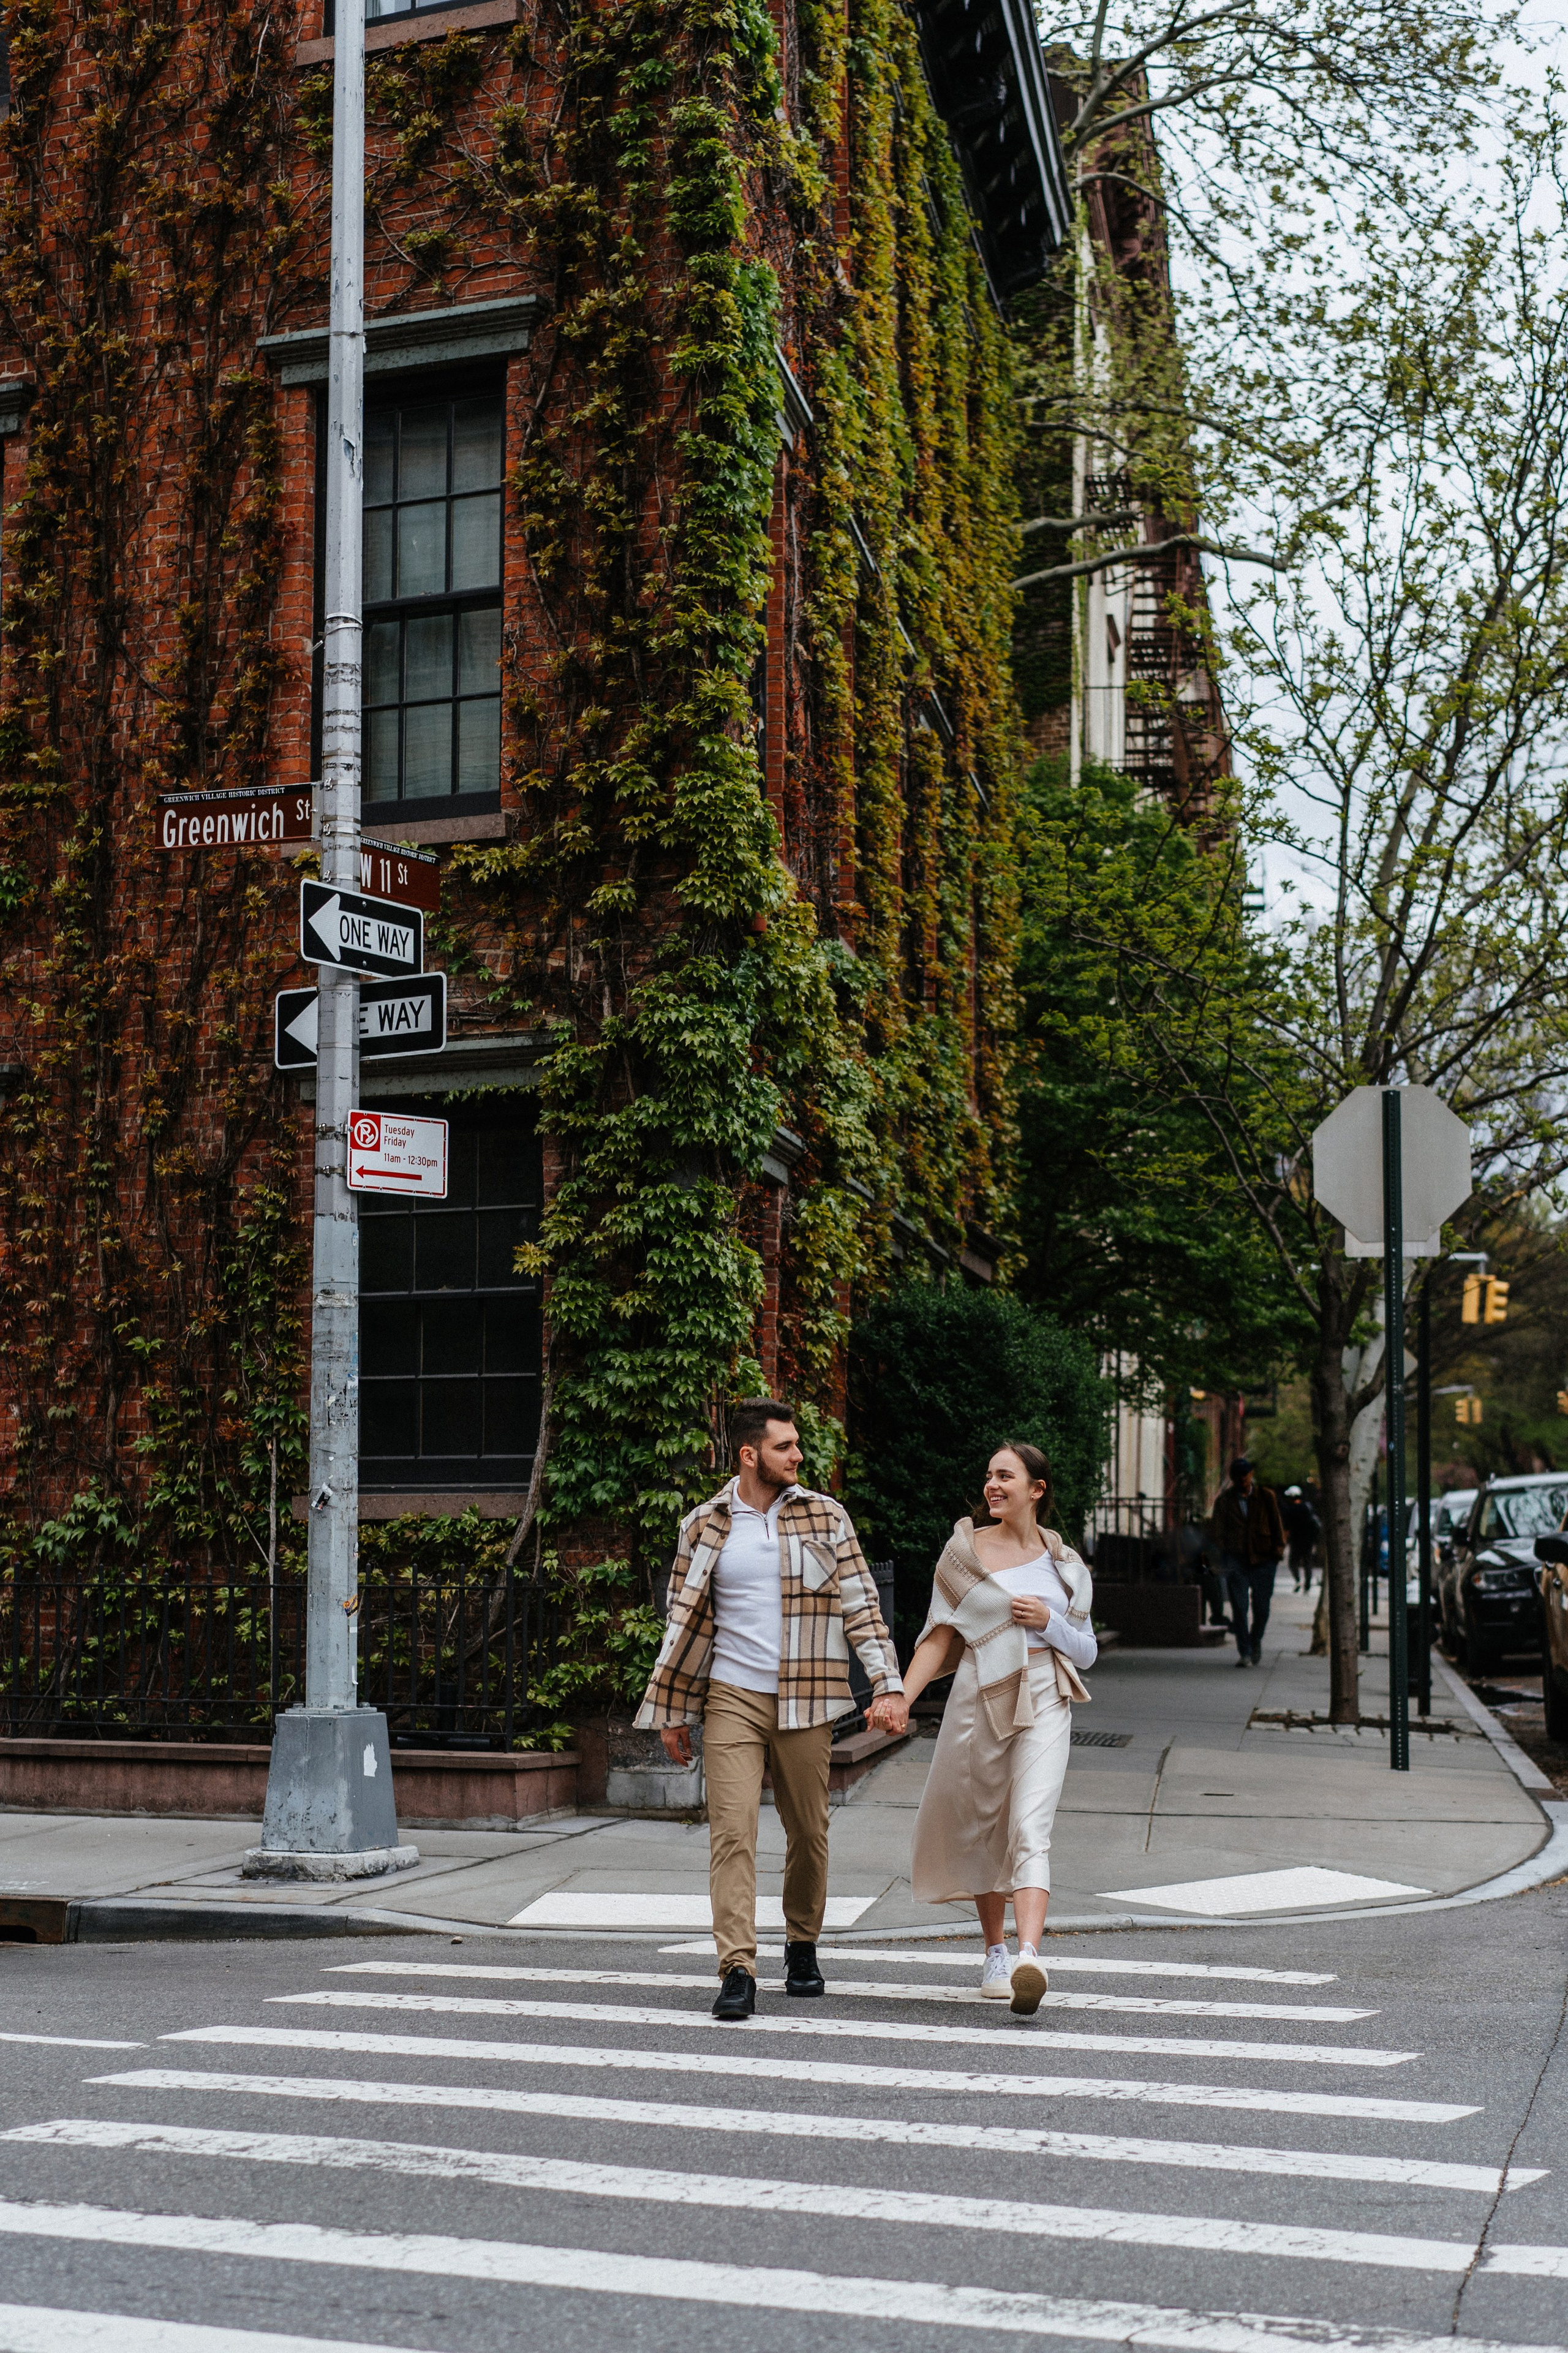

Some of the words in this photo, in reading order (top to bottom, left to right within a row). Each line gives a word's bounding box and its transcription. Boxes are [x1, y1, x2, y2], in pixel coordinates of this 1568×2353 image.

[164, 795, 199, 803] GREENWICH
[163, 802, 284, 848] Greenwich
[296, 799, 311, 821] St
[384, 844, 401, 854] VILLAGE
[401, 850, 418, 859] HISTORIC
[418, 854, 435, 864] DISTRICT
[360, 853, 372, 888] W
[380, 858, 391, 893] 11
[398, 863, 408, 885] St
[340, 915, 372, 949] ONE
[377, 924, 409, 957] WAY
[378, 1000, 425, 1032] WAY
[385, 1124, 415, 1138] Tuesday
[384, 1136, 406, 1149] Friday
[384, 1153, 401, 1163] 11am
[408, 1155, 438, 1168] 12:30pm
